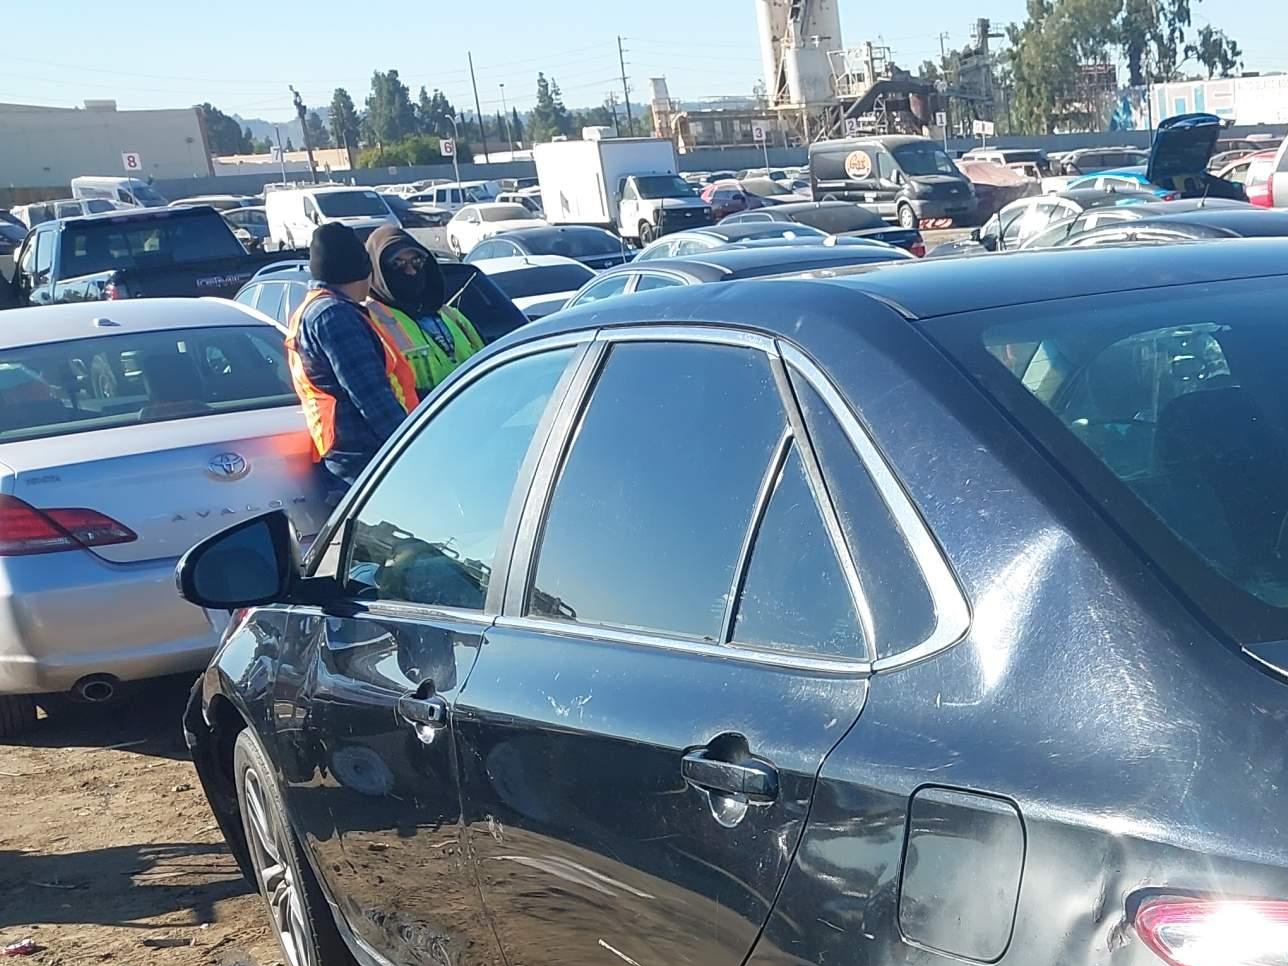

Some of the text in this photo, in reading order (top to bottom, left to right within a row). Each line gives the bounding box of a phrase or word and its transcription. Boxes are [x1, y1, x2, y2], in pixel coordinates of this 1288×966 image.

[754, 127, 763, 138] 3
[444, 141, 452, 154] 6
[127, 155, 137, 168] 8
